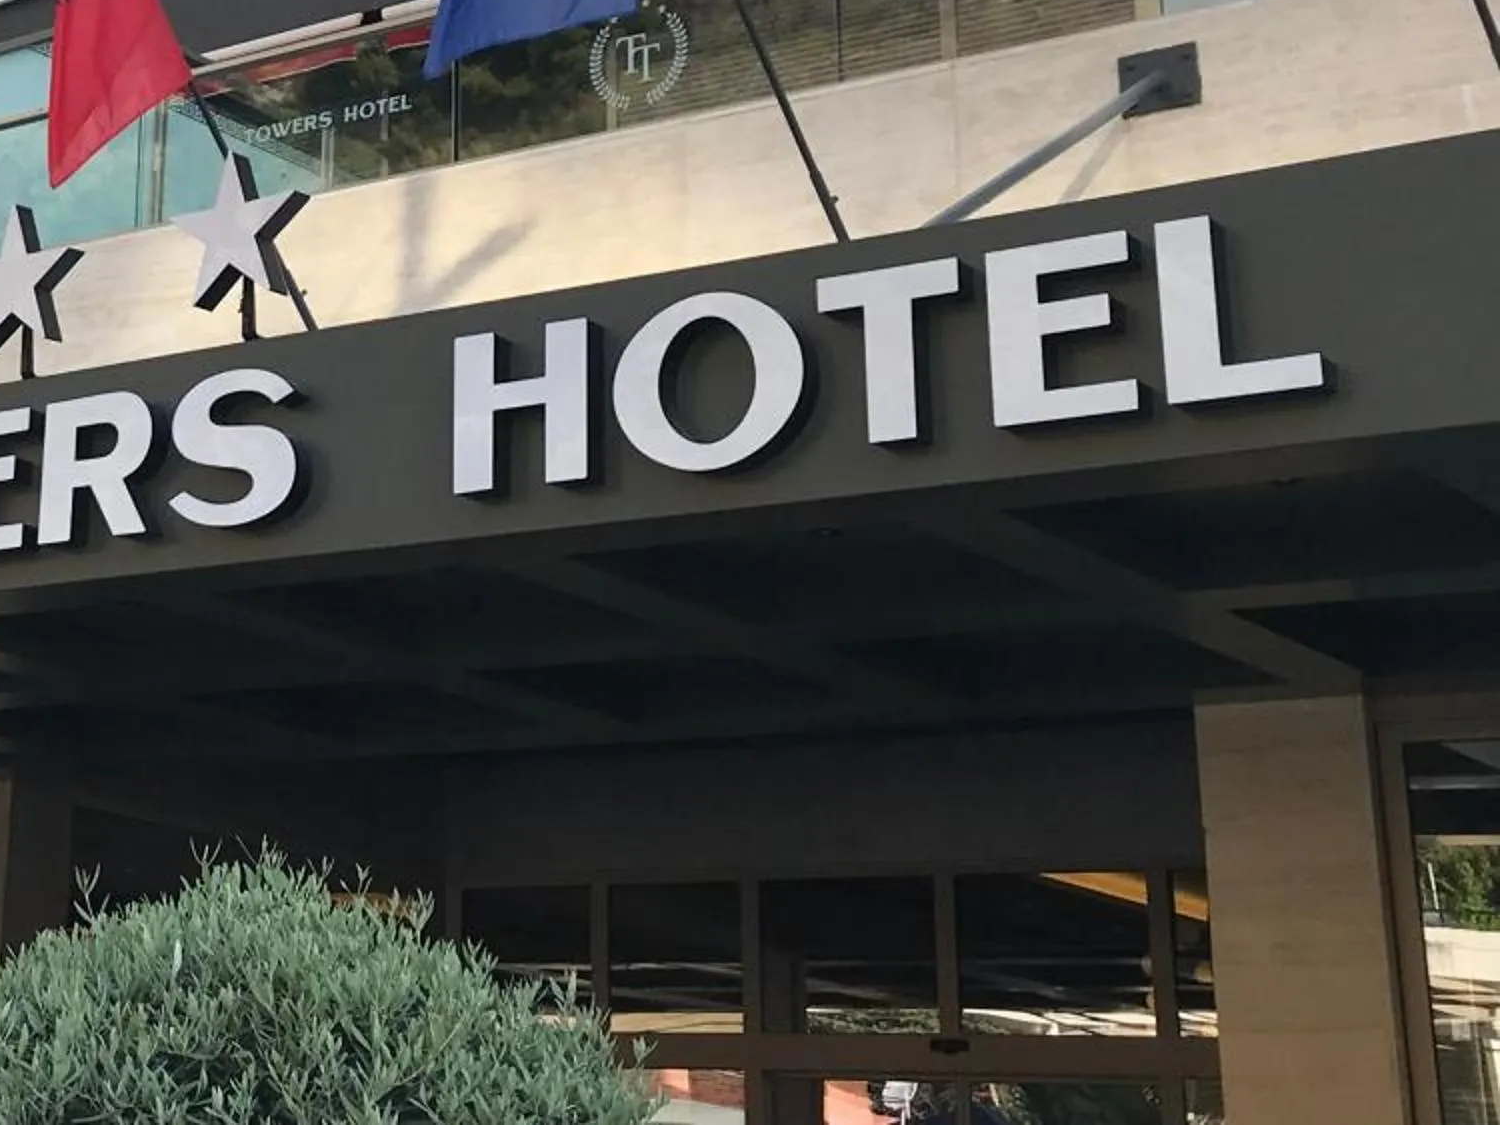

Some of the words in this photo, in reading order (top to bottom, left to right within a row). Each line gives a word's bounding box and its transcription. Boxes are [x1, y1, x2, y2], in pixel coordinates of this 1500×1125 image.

[244, 110, 334, 143] TOWERS
[343, 93, 414, 123] HOTEL
[452, 214, 1325, 495] HOTEL
